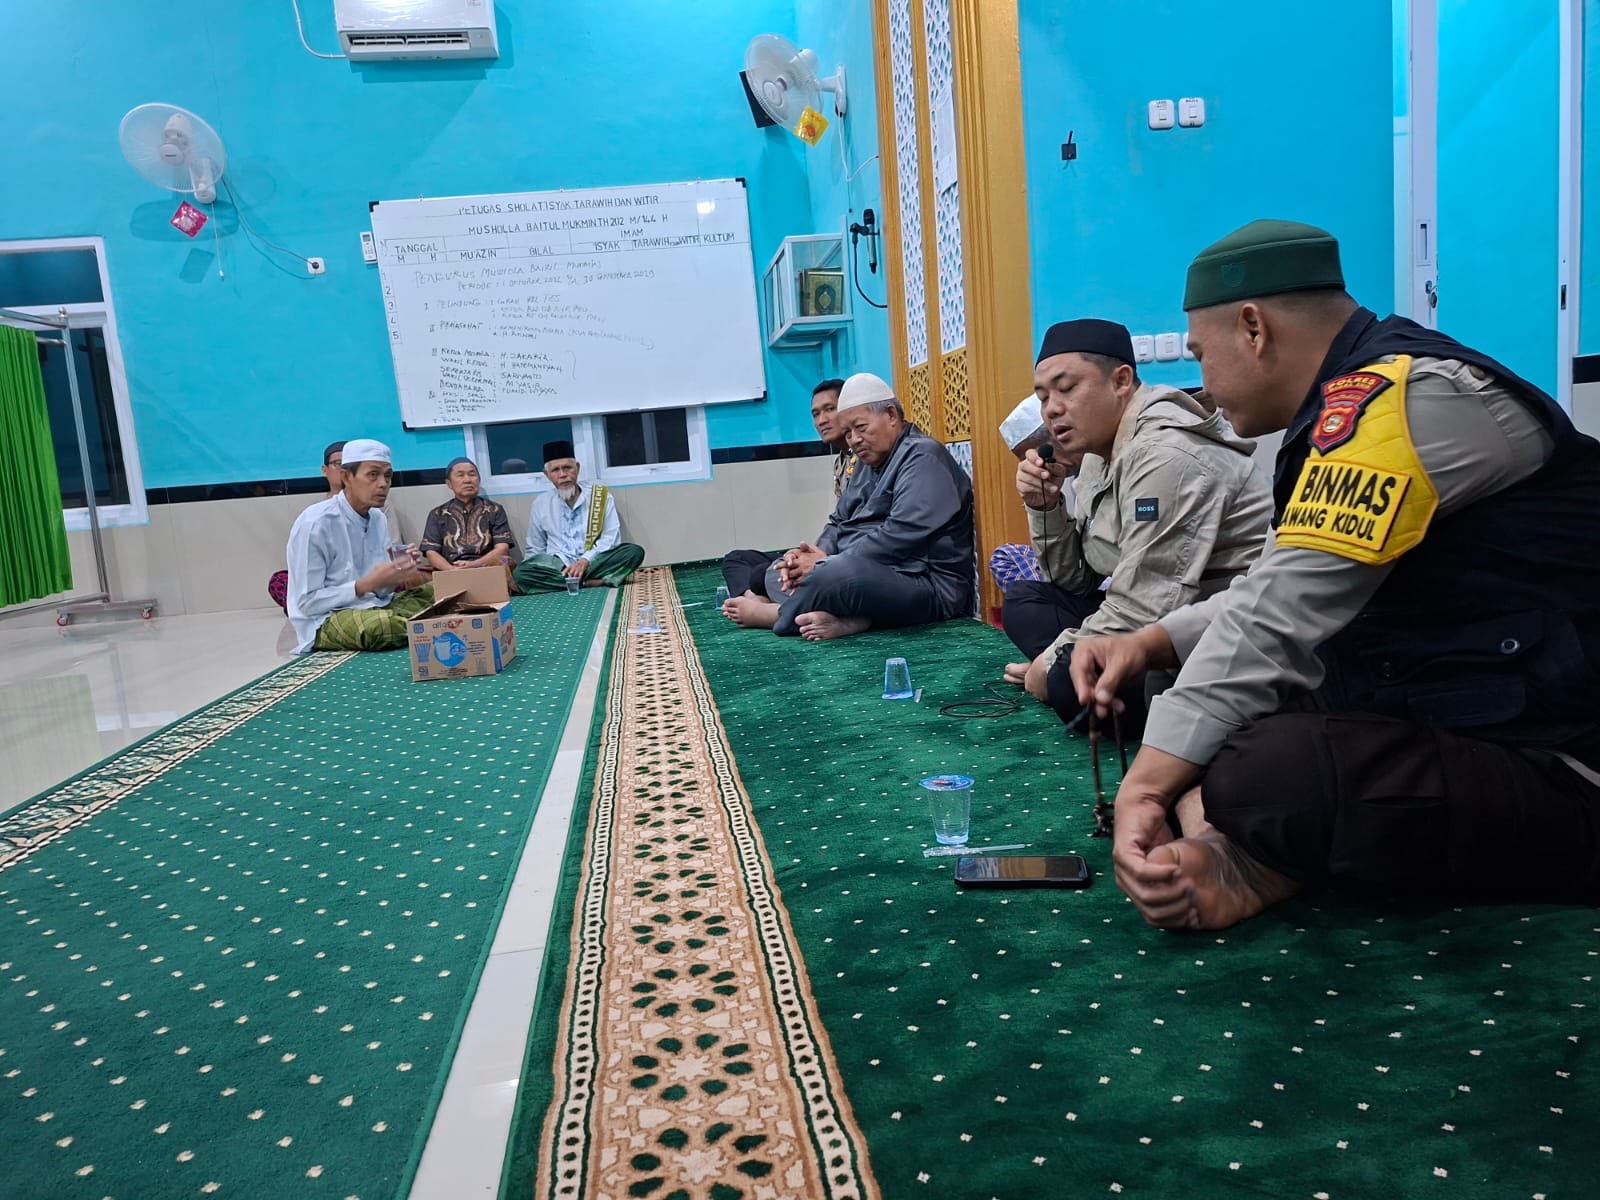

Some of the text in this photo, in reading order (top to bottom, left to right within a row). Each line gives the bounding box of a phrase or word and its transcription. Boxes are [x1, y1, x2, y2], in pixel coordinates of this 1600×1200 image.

[575, 197, 612, 210] TARAWIH
[614, 196, 632, 207] DAN
[634, 195, 659, 206] WITIR
[468, 223, 521, 235] MUSHOLLA
[662, 213, 668, 223] H
[620, 229, 644, 239] IMAM
[394, 242, 439, 254] TANGGAL
[529, 246, 555, 256] BILAL
[633, 238, 669, 249] TARAWIH
[703, 232, 735, 243] KULTUM
[397, 253, 437, 264] M H
[385, 285, 392, 295] 2
[387, 301, 395, 311] 3
[392, 331, 400, 341] 5
[1327, 376, 1377, 390] POLRES
[1299, 465, 1397, 516] BINMAS
[1281, 506, 1376, 541] AWANG KIDUL
